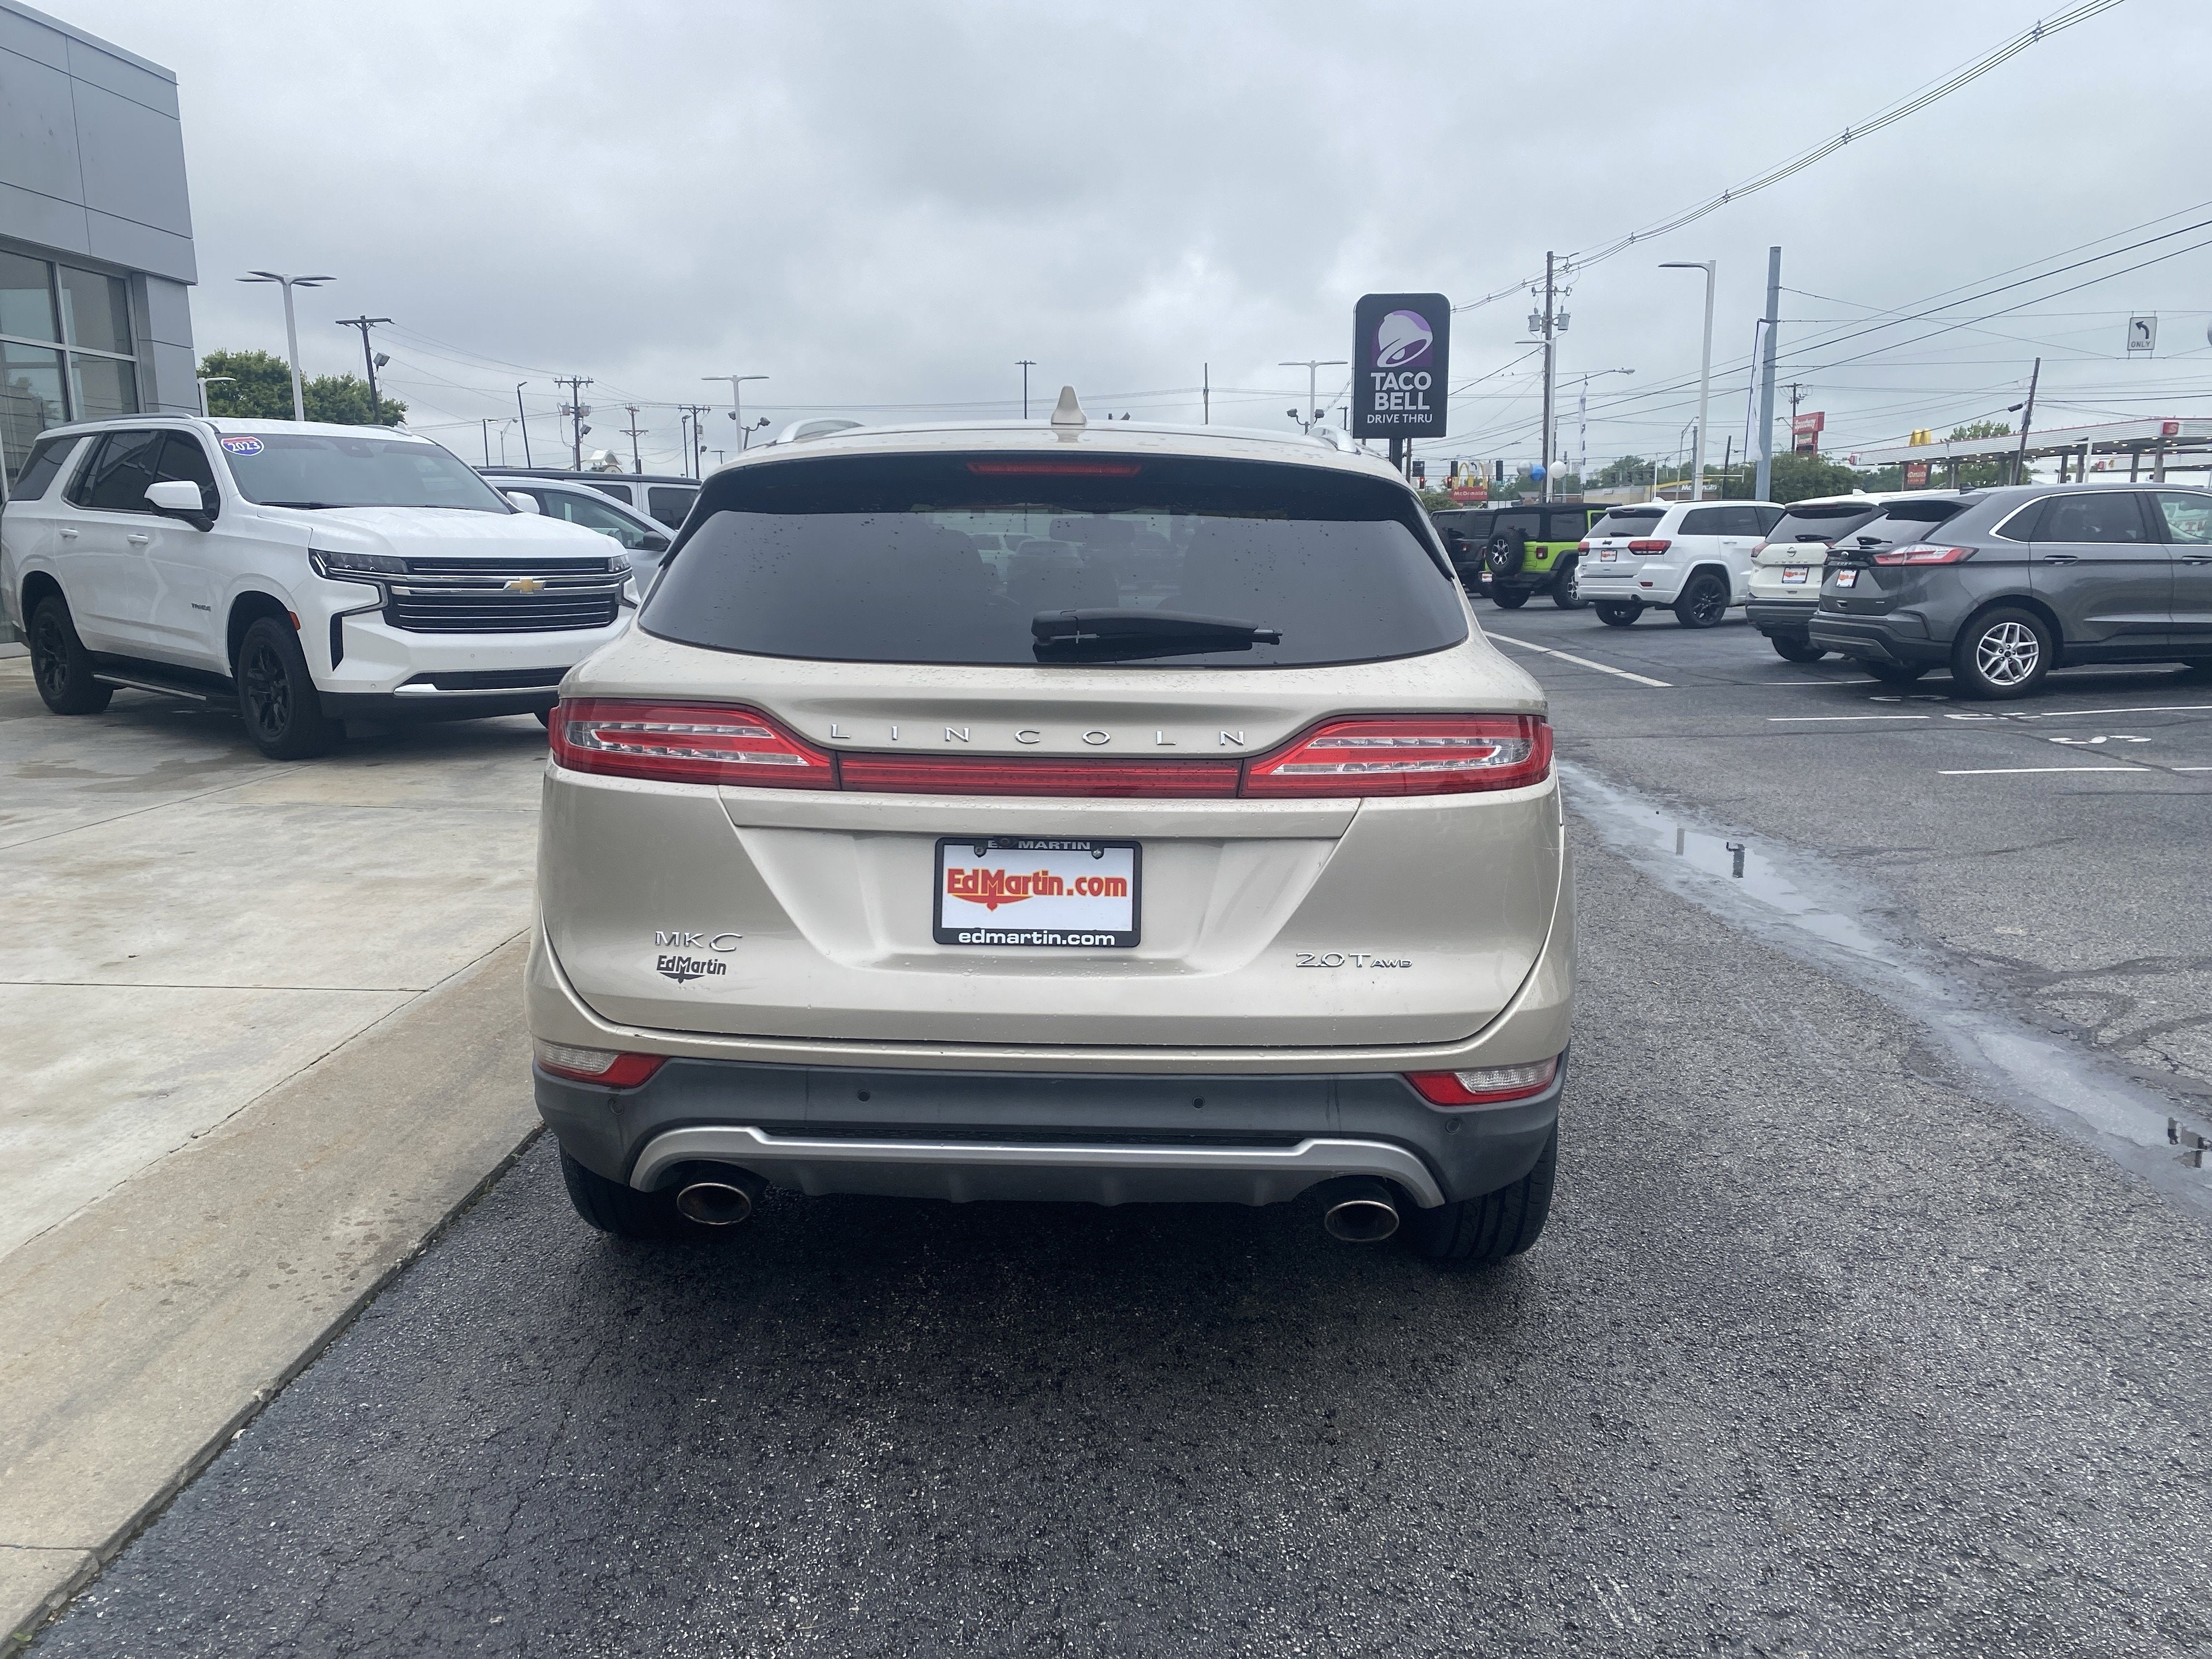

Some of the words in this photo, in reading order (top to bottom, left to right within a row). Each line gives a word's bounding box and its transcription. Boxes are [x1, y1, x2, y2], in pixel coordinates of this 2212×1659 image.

[1370, 371, 1432, 391] TACO
[1375, 392, 1430, 410] BELL
[1367, 414, 1400, 424] DRIVE
[1402, 414, 1432, 423] THRU
[227, 441, 261, 452] 2023
[831, 724, 1244, 746] LINCOLN
[1018, 840, 1091, 850] MARTIN
[947, 868, 1127, 897] EdMartin.com
[656, 931, 743, 952] MKC
[958, 929, 1115, 946] edmartin.com
